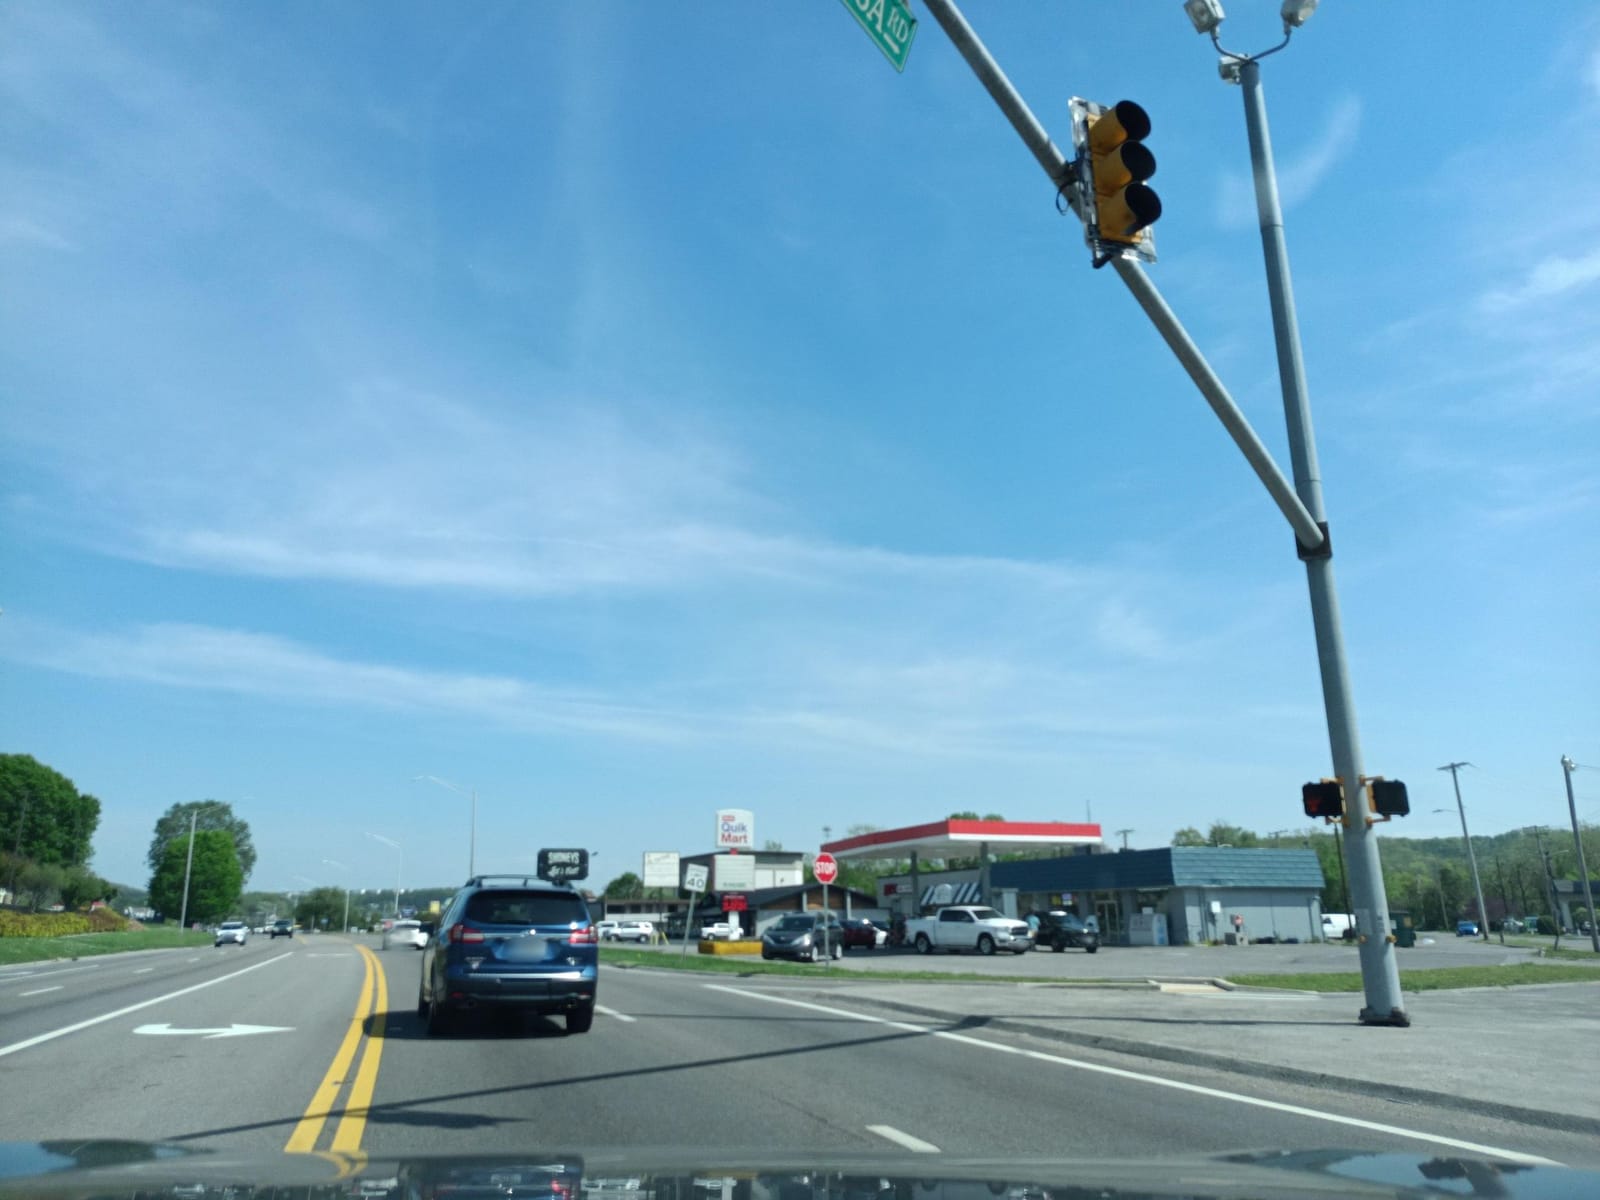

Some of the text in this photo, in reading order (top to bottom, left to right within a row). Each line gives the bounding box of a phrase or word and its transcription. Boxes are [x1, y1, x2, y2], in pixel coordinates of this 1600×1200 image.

[887, 7, 909, 43] RD
[721, 822, 748, 833] Quik
[721, 832, 748, 844] Mart
[815, 861, 836, 875] STOP
[686, 878, 705, 889] 40
